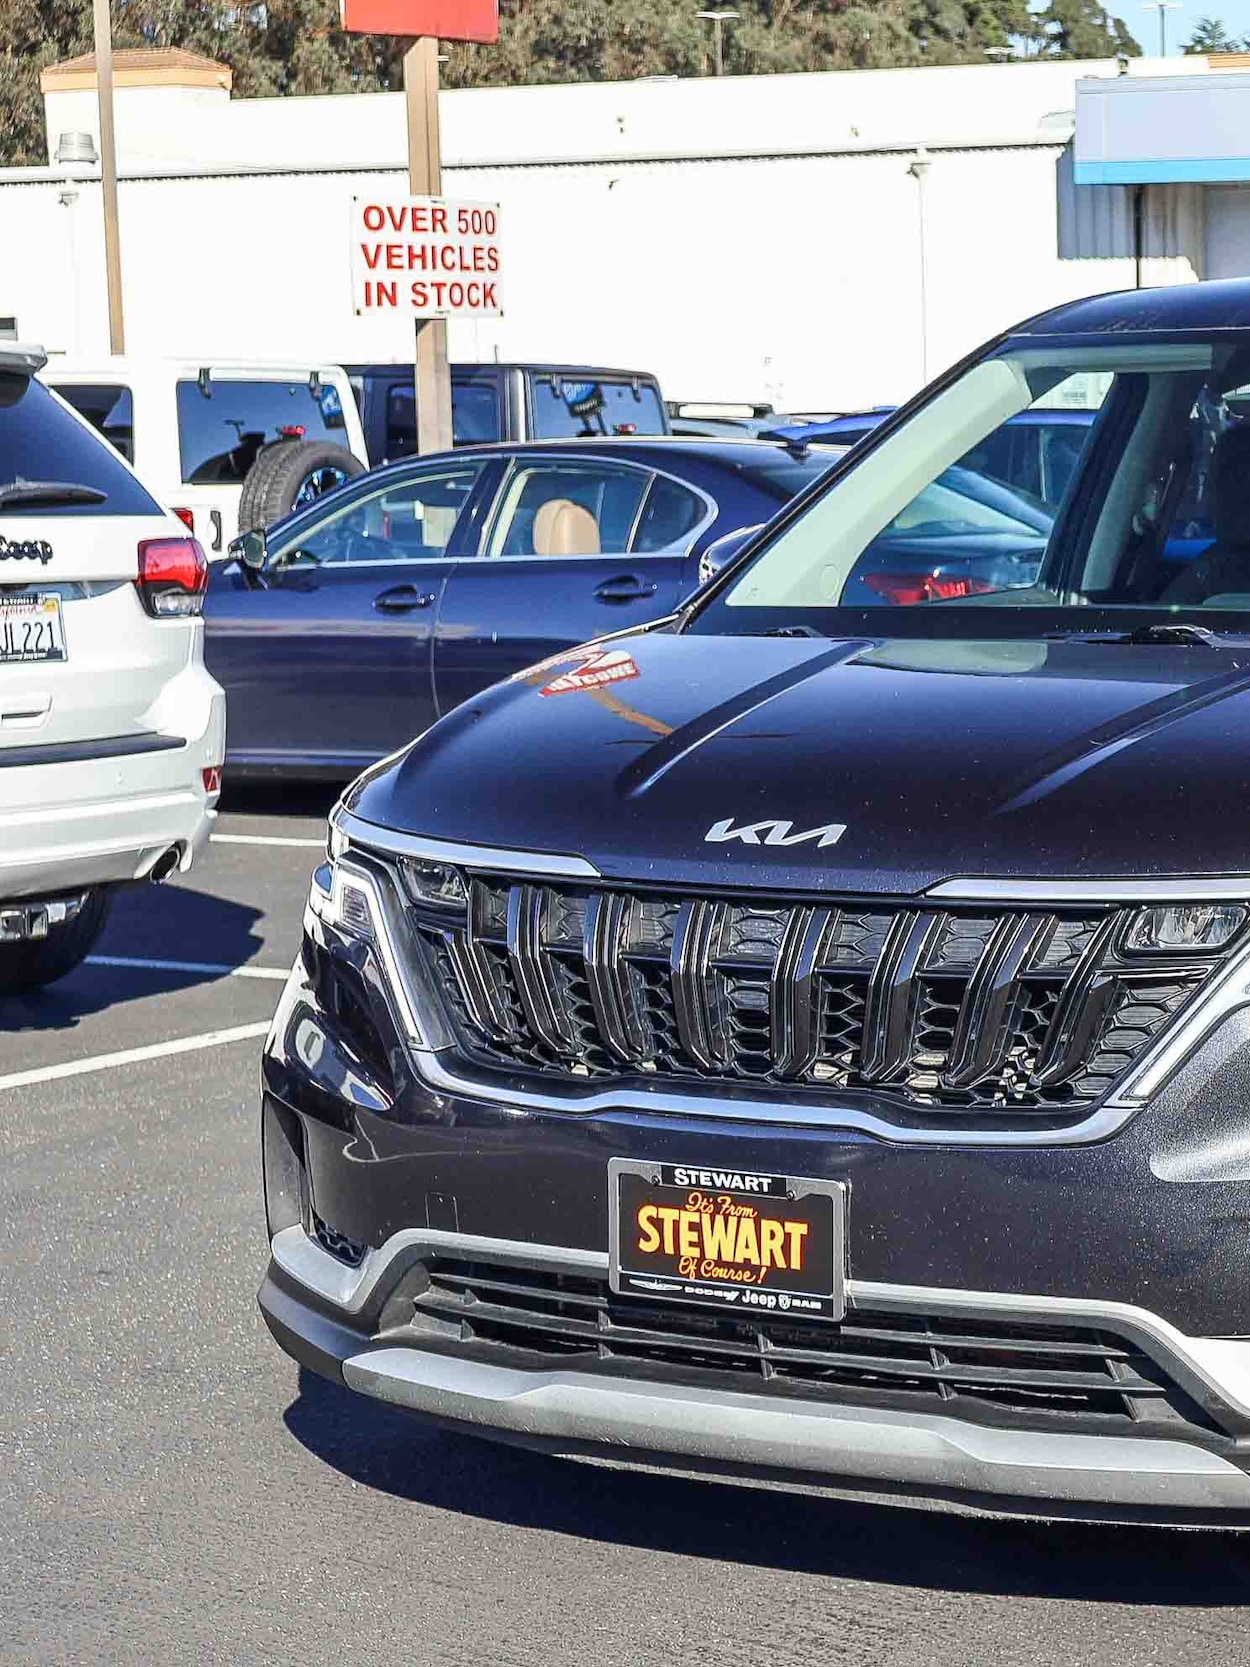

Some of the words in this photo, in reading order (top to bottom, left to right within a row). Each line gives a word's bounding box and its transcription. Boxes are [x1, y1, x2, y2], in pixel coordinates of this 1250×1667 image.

[362, 205, 449, 233] OVER
[457, 208, 497, 235] 500
[360, 243, 499, 272] VEHICLES
[364, 281, 398, 307] IN
[411, 281, 497, 308] STOCK
[674, 1168, 772, 1192] STEWART
[685, 1191, 715, 1213] It's
[717, 1195, 757, 1217] From
[636, 1205, 809, 1271] STEWART
[679, 1256, 698, 1281] Of
[742, 1289, 777, 1309] Jeep
